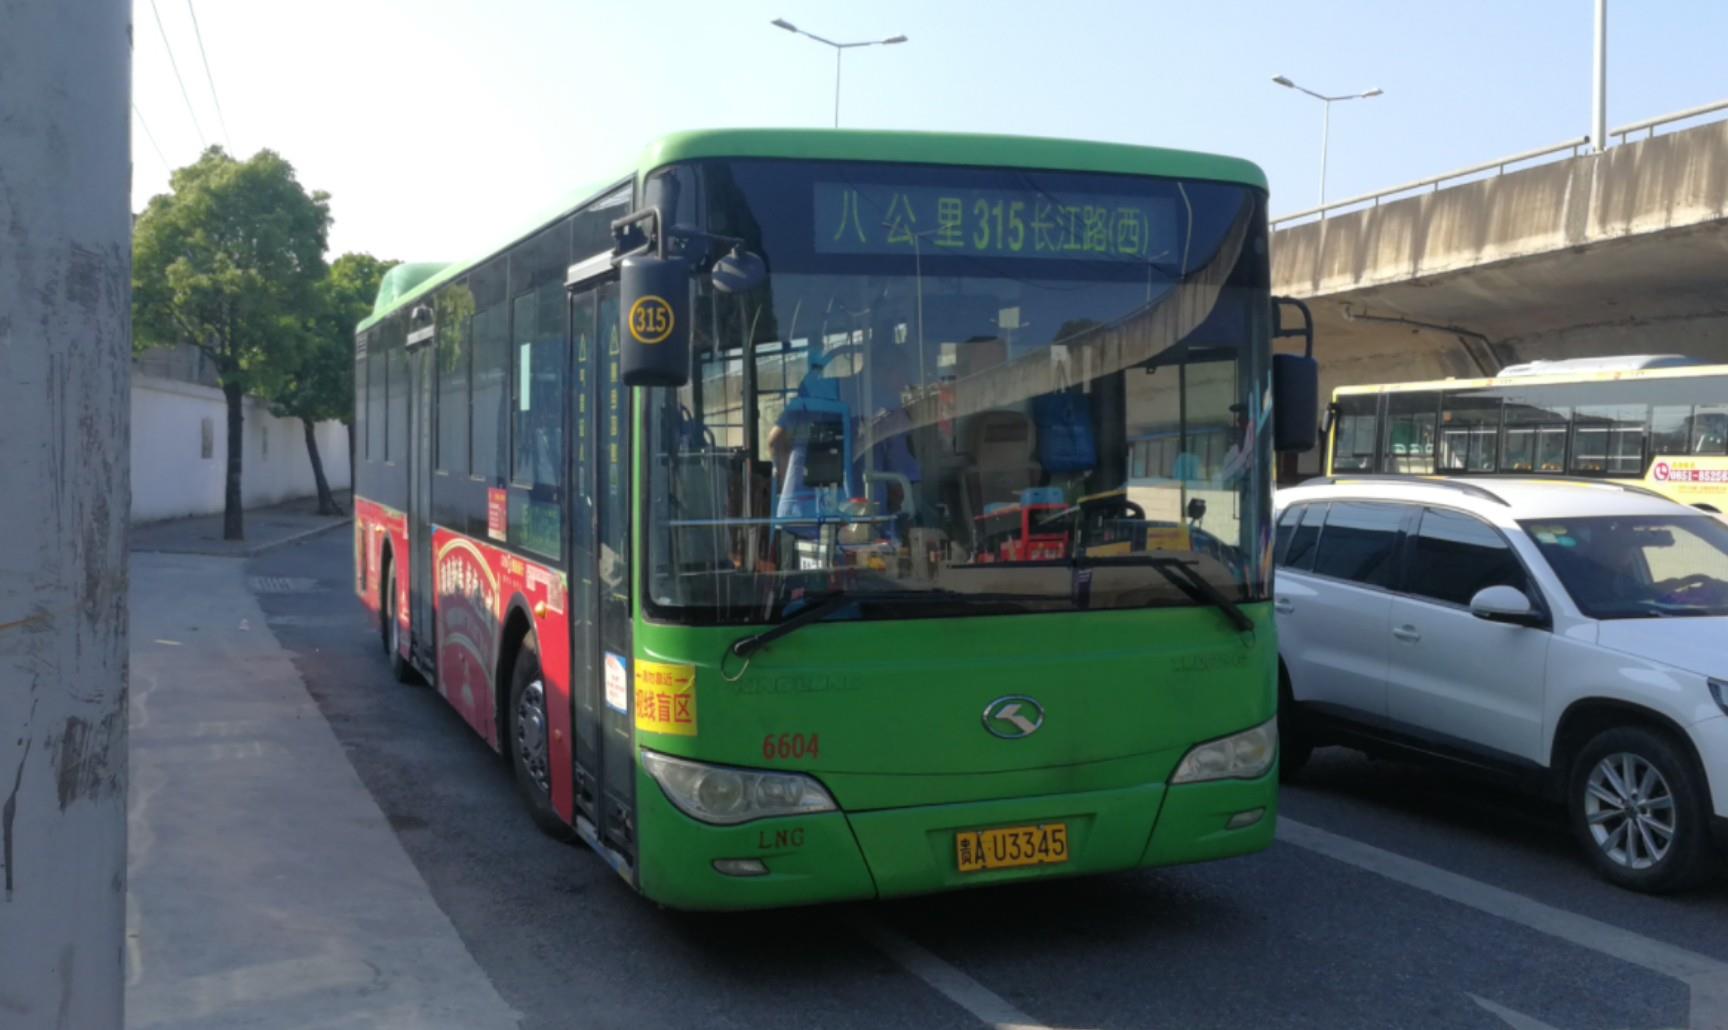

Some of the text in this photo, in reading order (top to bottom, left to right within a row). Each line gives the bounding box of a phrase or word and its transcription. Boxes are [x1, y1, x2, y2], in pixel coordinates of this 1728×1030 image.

[833, 189, 964, 248] 八公里
[973, 199, 1024, 251] 315
[635, 306, 666, 333] 315
[763, 733, 819, 760] 6604
[758, 829, 805, 850] LNG
